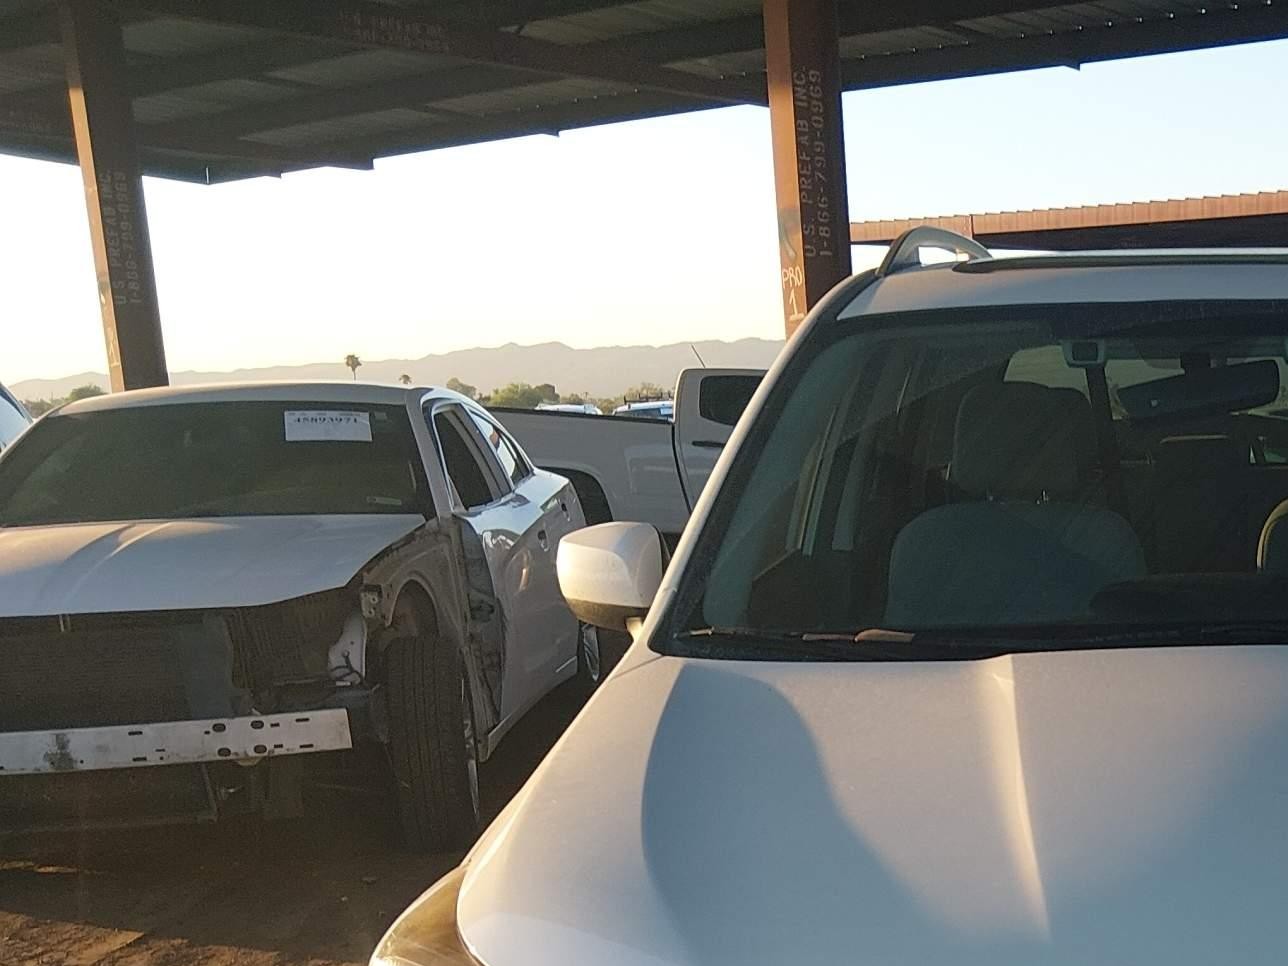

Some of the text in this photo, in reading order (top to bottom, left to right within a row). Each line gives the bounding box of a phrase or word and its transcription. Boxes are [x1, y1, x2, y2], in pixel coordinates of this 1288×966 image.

[793, 65, 809, 109] INC.
[796, 118, 815, 206] PREFAB
[808, 68, 833, 258] 1-866-799-0969
[781, 265, 804, 290] PRO
